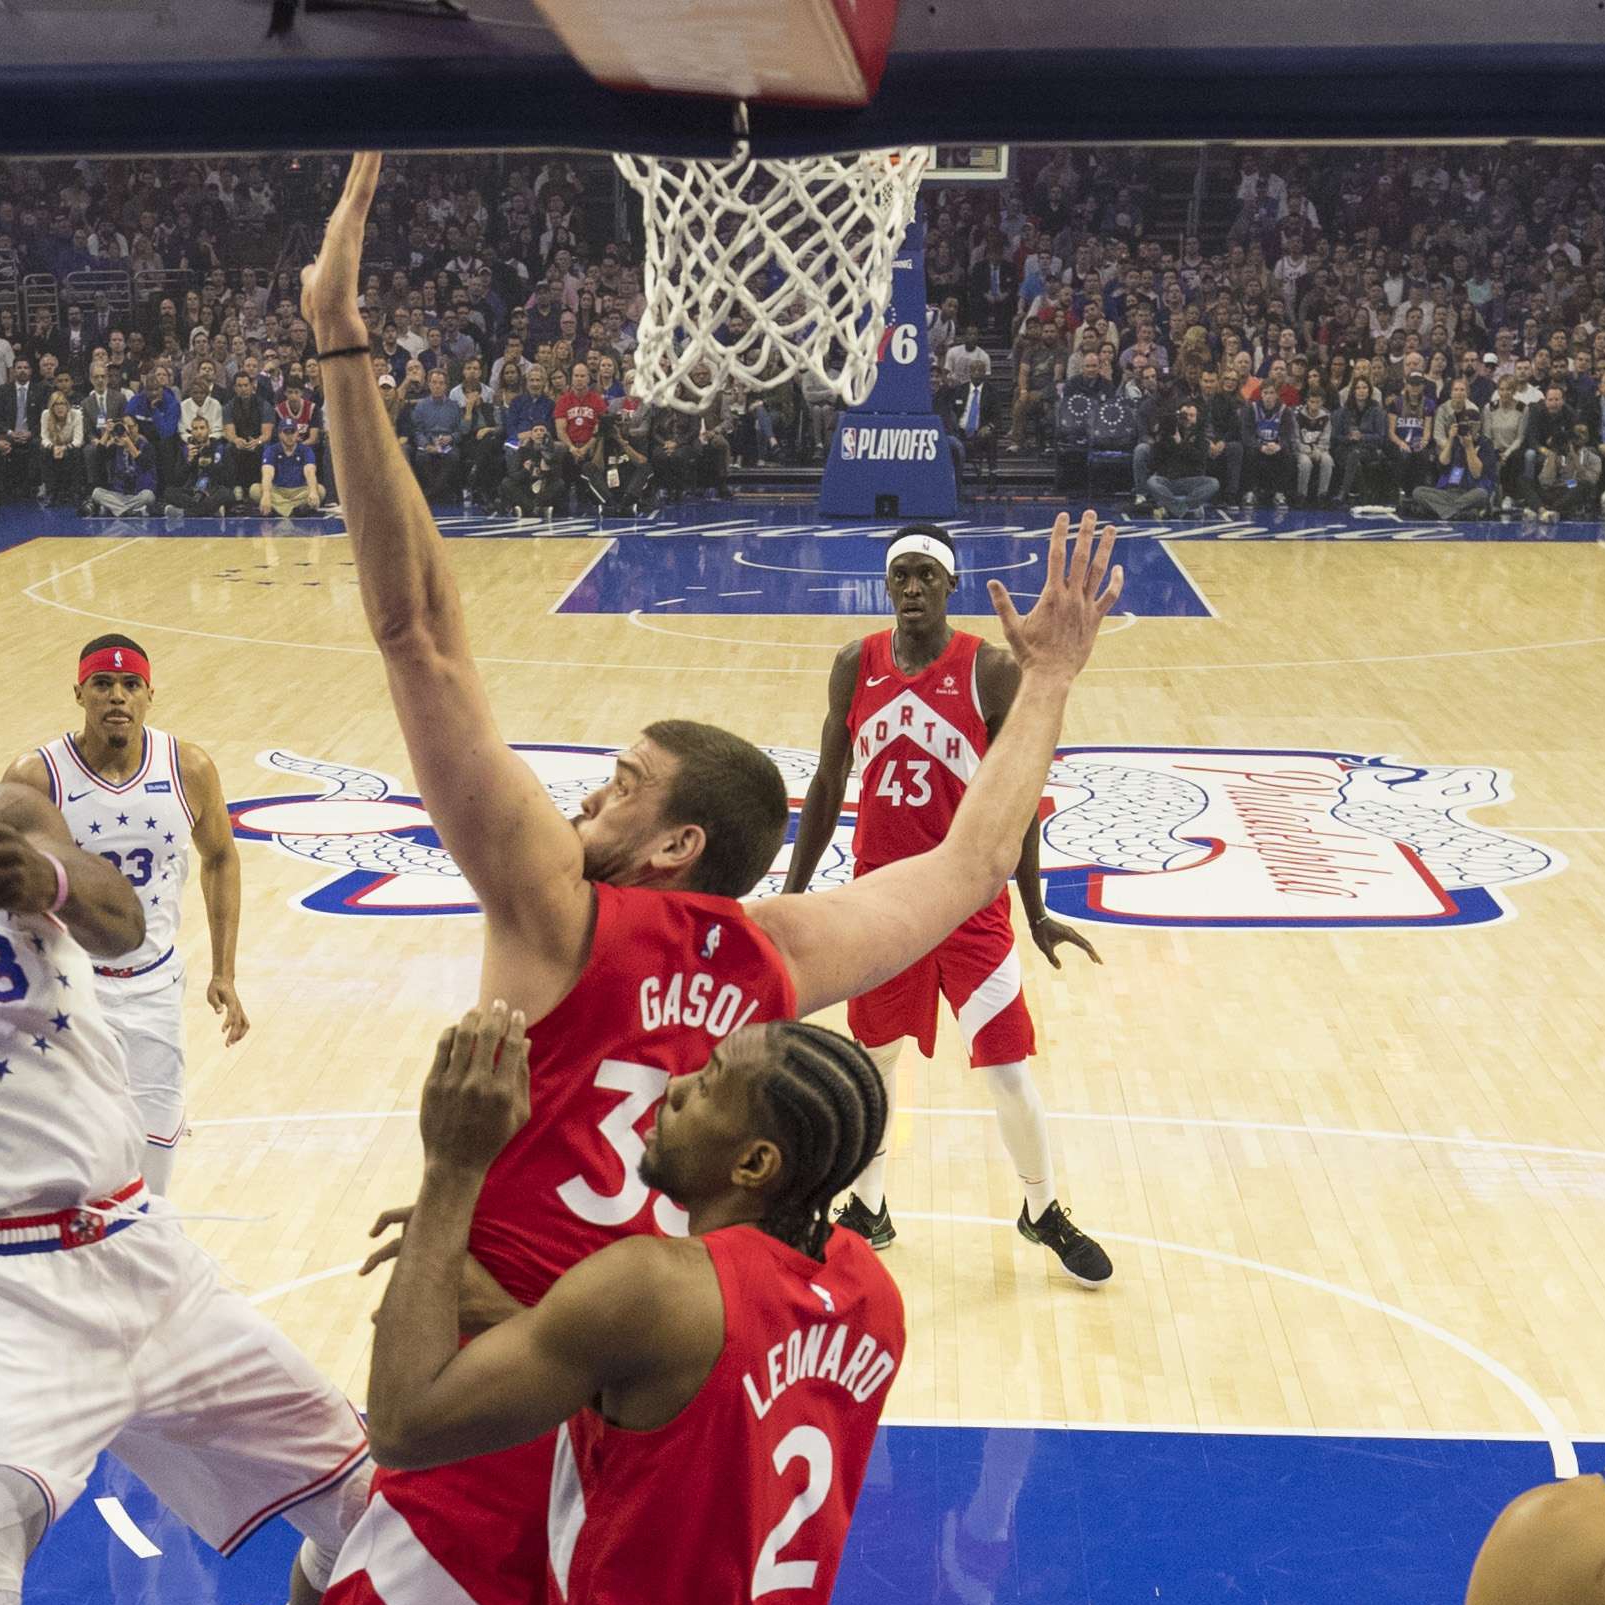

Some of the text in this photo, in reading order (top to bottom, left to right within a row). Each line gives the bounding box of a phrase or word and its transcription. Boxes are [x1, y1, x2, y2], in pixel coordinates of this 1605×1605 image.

[857, 427, 939, 461] PLAYOFFS
[859, 704, 962, 759] NORTH
[875, 760, 932, 807] 43
[1172, 764, 1393, 898] Philadelphia
[556, 1058, 691, 1238] 3
[741, 1323, 896, 1422] LEONARD
[750, 1424, 834, 1602] 2
